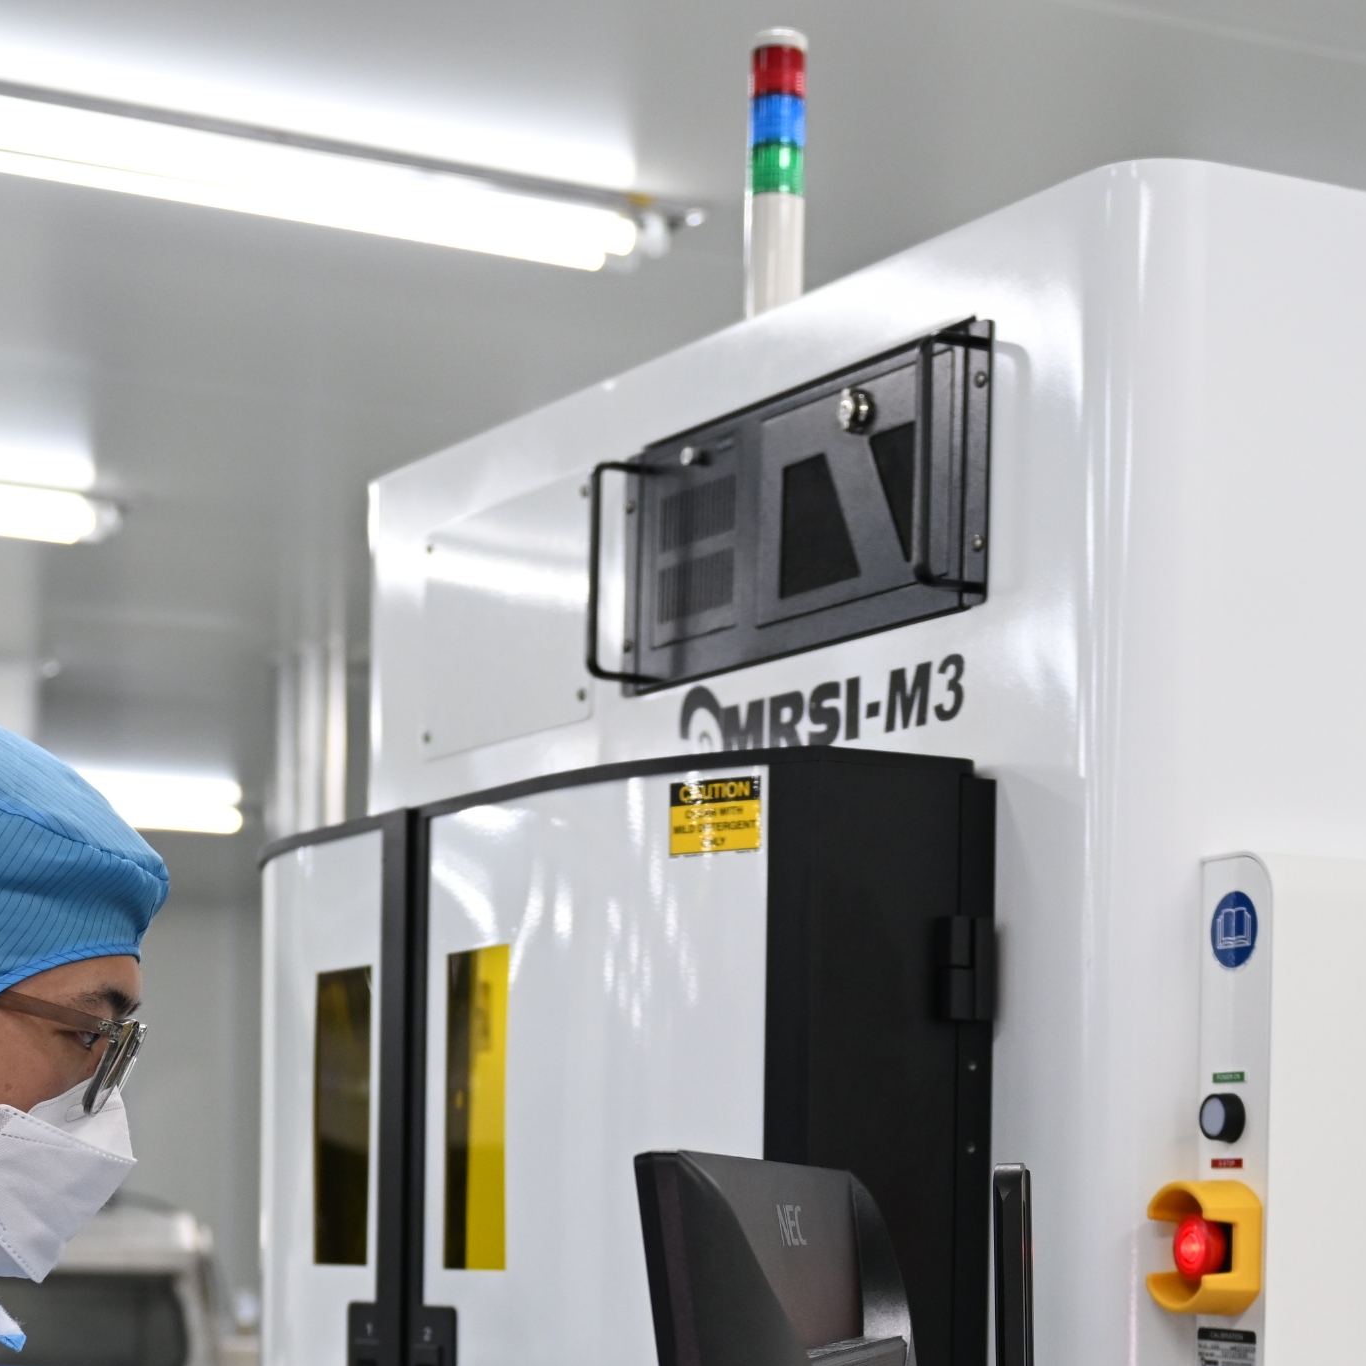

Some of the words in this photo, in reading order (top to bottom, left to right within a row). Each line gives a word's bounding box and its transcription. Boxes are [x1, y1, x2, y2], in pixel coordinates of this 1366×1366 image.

[776, 1204, 808, 1247] NEC
[365, 1322, 374, 1337] 1
[422, 1326, 433, 1343] 2
